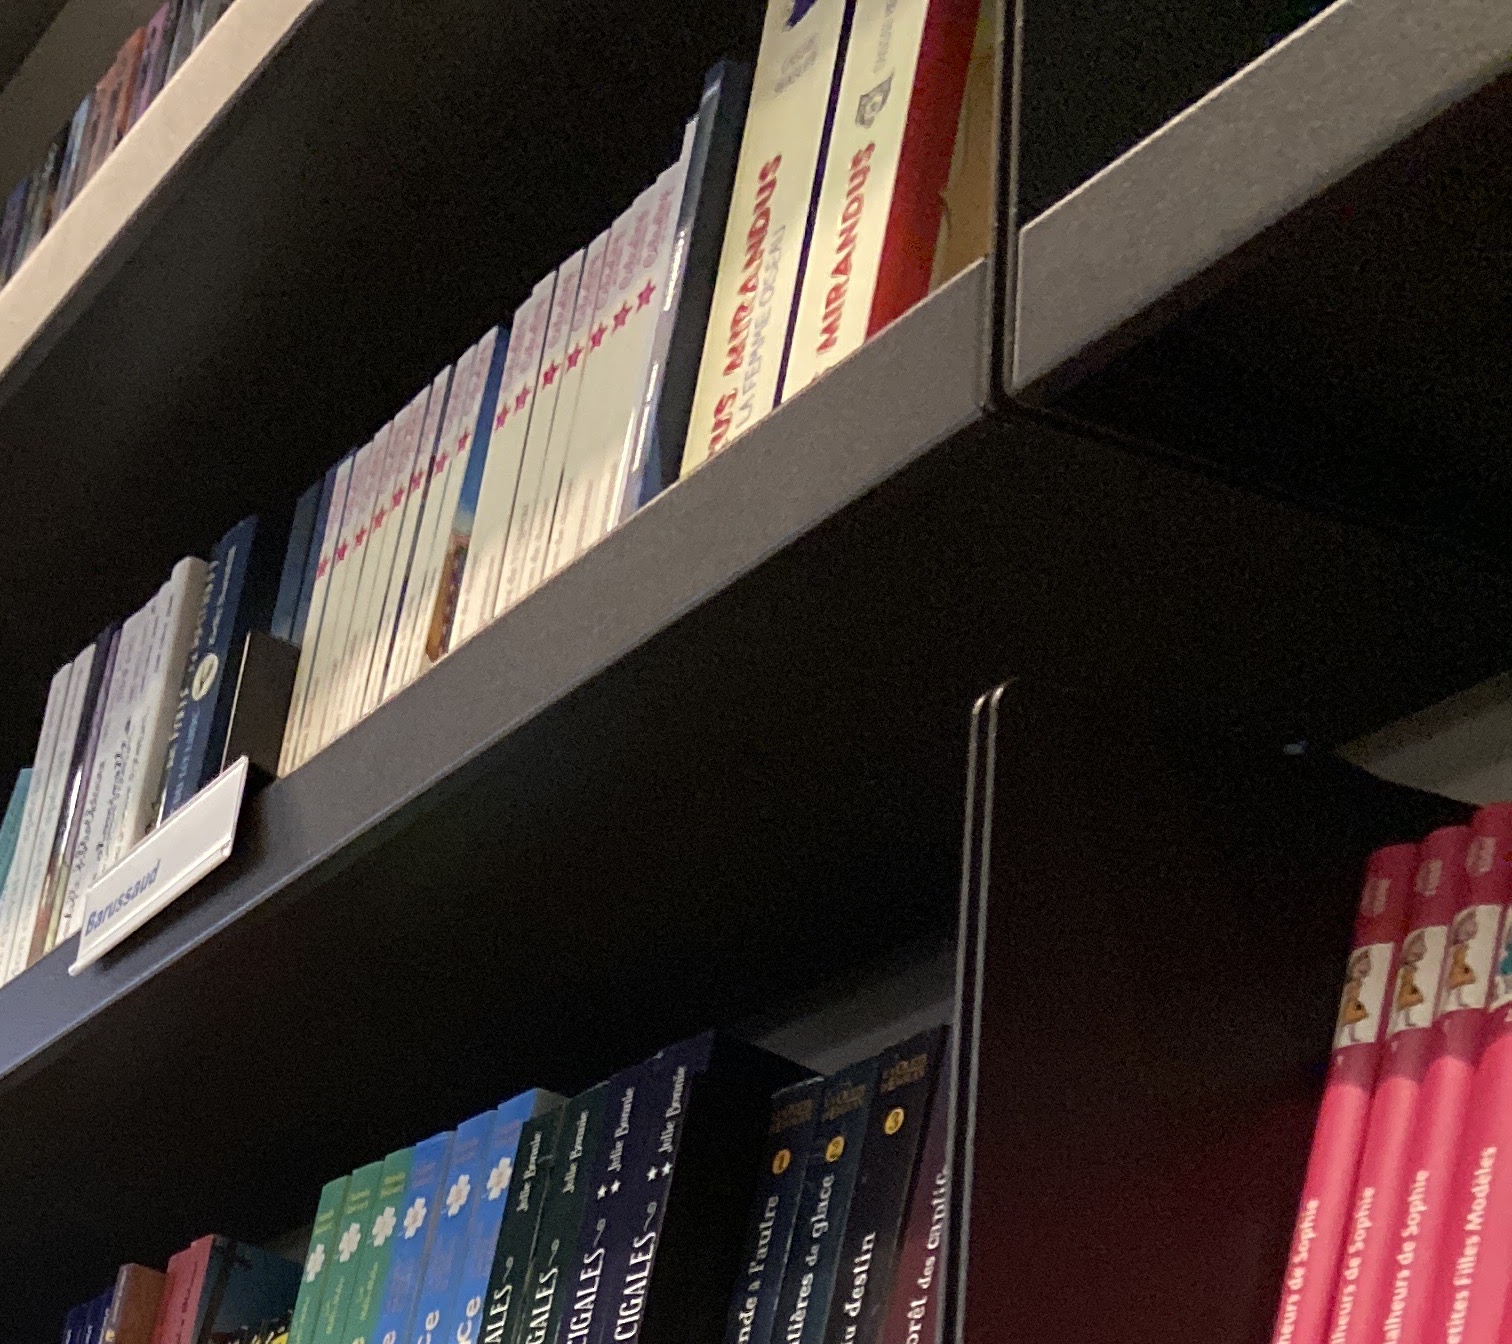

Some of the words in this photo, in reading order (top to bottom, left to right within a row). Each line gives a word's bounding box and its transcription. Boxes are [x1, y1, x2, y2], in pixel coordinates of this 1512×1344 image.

[723, 154, 782, 376] MIRANDUS
[817, 141, 876, 355] MIRANDUS
[85, 857, 161, 937] Barussaud
[810, 1174, 834, 1238] glace
[1349, 1187, 1376, 1254] Sophie
[1401, 1170, 1429, 1237] Sophie
[1464, 1147, 1497, 1230] Modèles
[805, 1243, 819, 1267] de
[1292, 1199, 1319, 1263] Sophie
[1397, 1241, 1416, 1265] de
[1453, 1235, 1481, 1286] Filles
[614, 1231, 656, 1342] CIGALES
[844, 1231, 876, 1317] destin
[917, 1256, 935, 1289] des
[1288, 1267, 1305, 1291] de
[1345, 1257, 1362, 1280] de
